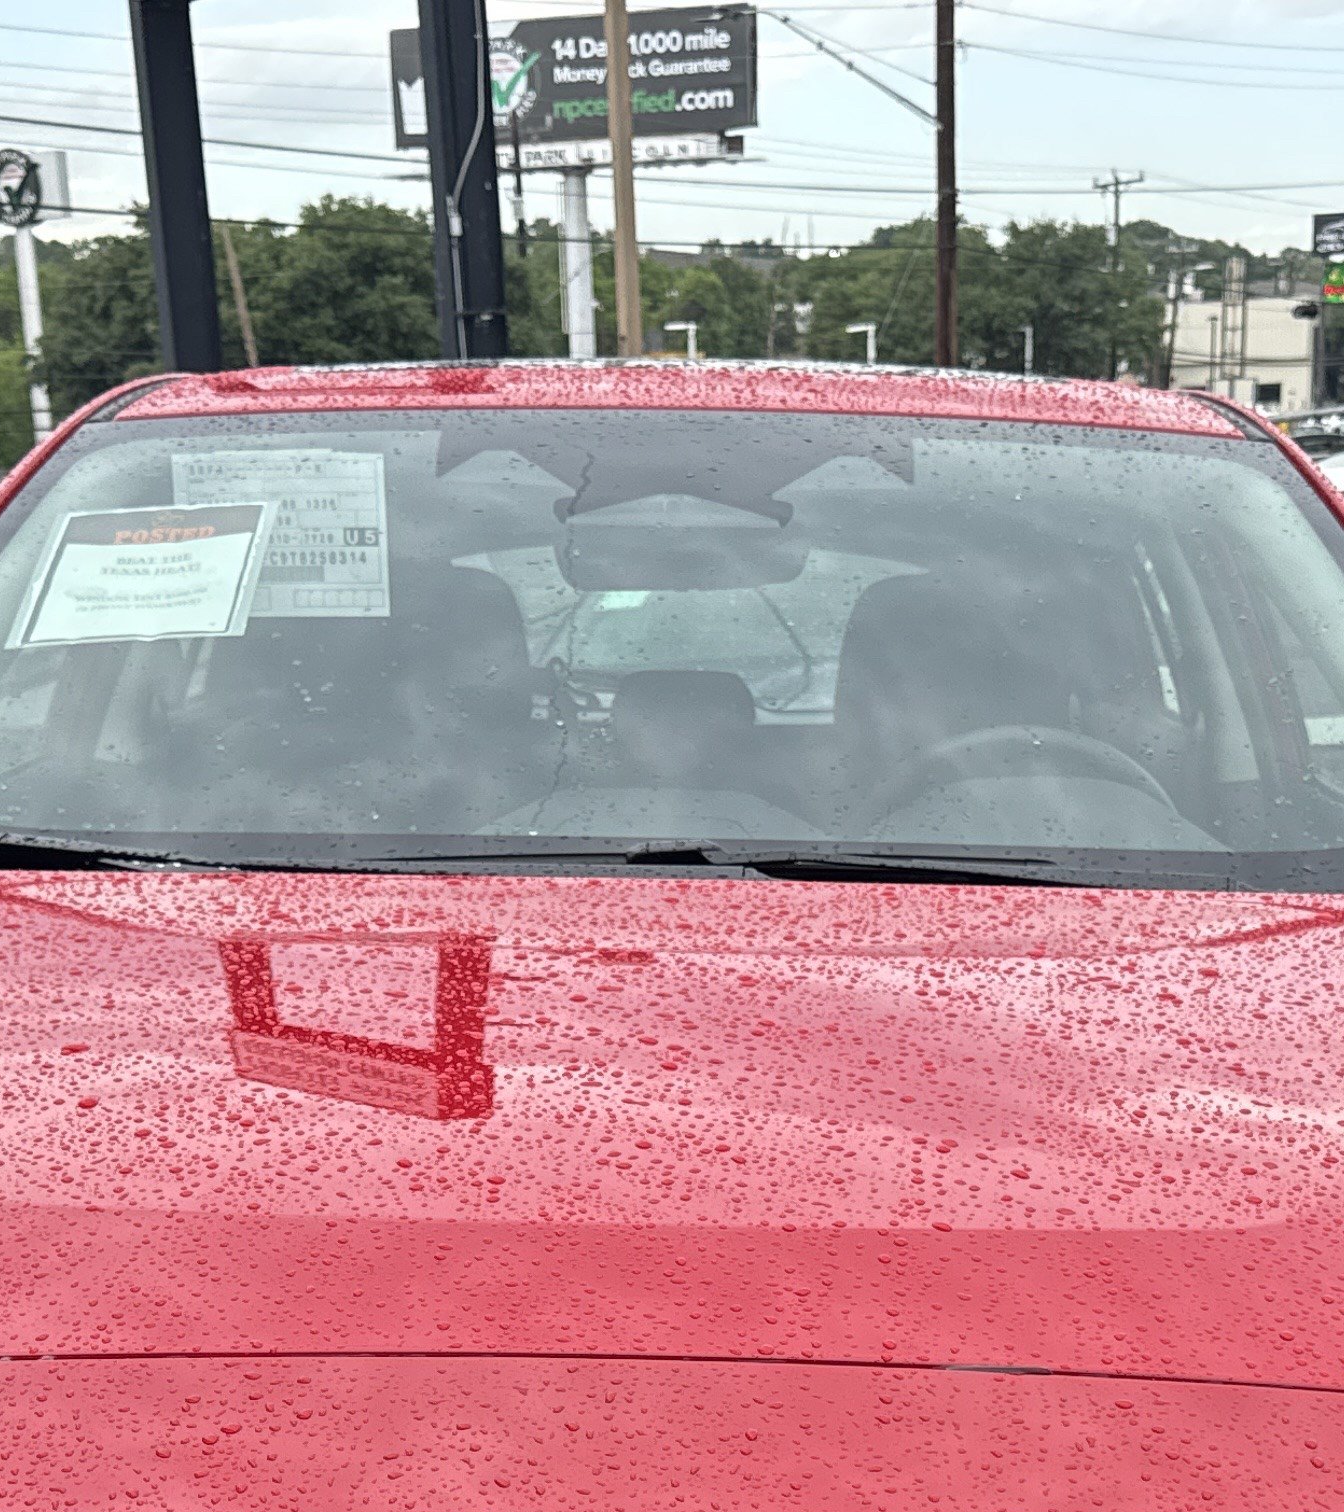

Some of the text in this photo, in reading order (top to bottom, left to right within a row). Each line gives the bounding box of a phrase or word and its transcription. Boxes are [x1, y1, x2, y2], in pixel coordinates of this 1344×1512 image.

[552, 36, 577, 60] 14
[579, 36, 608, 59] Da
[685, 26, 732, 52] mile
[553, 66, 608, 84] Money
[648, 57, 732, 77] Guarantee
[553, 88, 735, 123] npcefied.com
